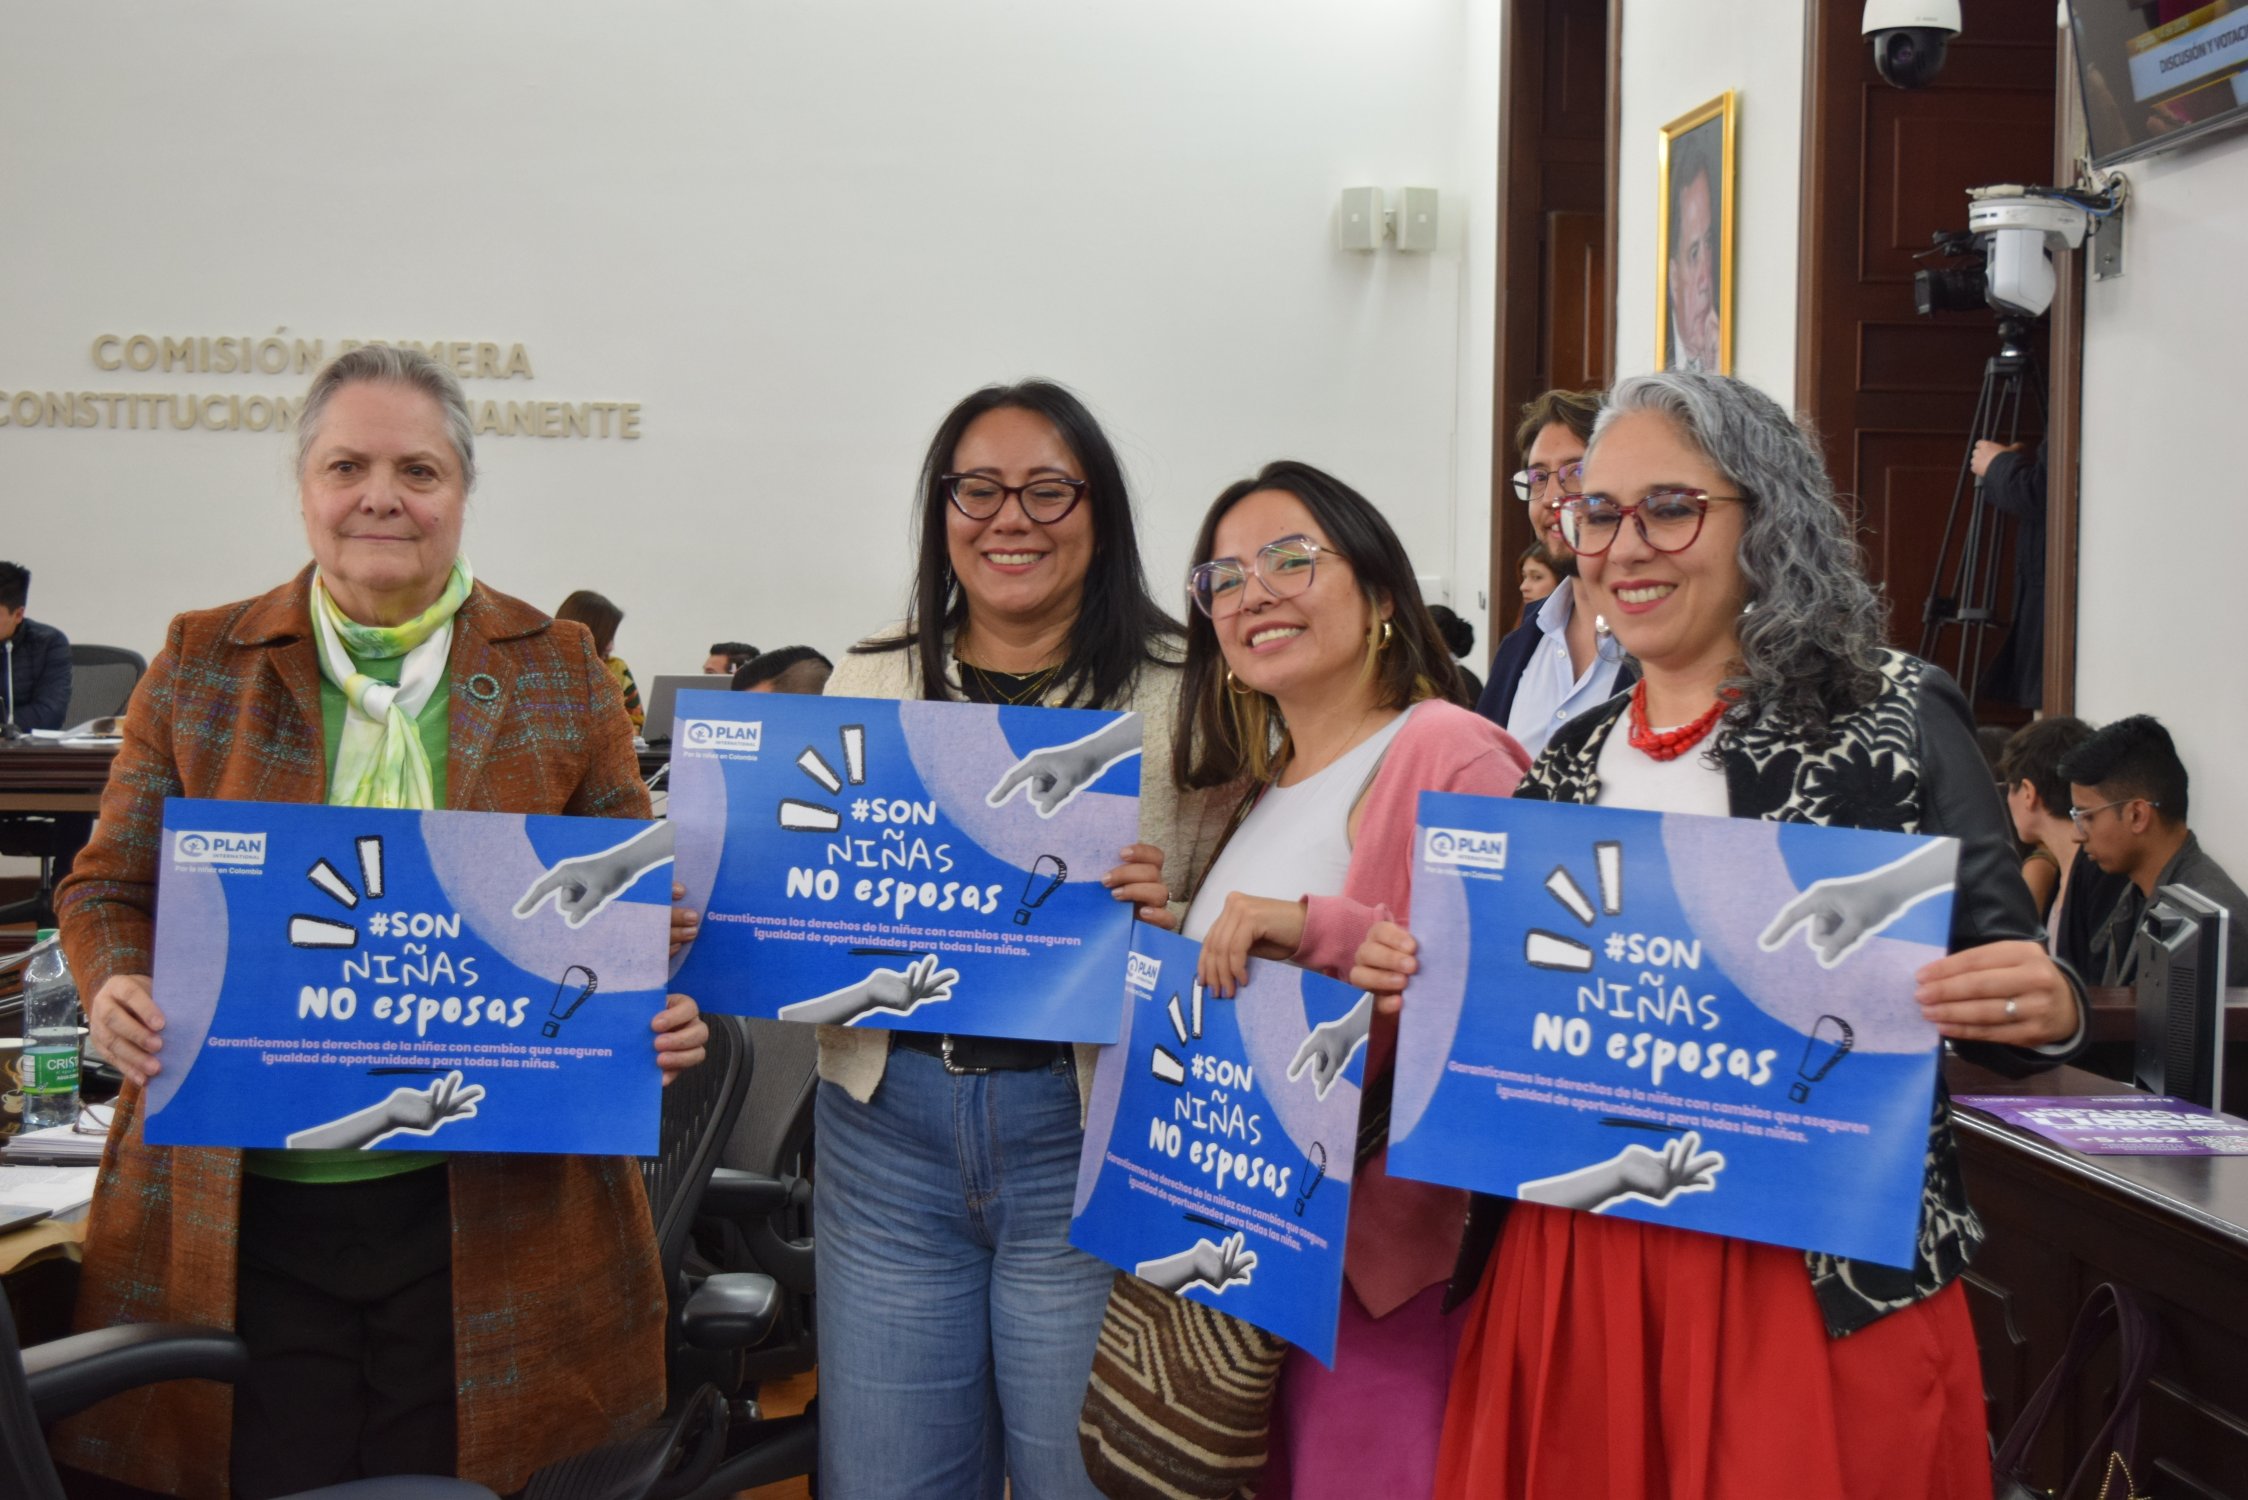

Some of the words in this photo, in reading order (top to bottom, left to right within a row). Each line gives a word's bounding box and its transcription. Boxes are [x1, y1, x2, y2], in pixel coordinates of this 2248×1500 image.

[2159, 42, 2207, 74] DISCUSIÓN
[2213, 25, 2248, 51] VOTAC
[92, 325, 322, 375] COMISIÓN
[716, 726, 757, 740] PLAN
[851, 797, 936, 826] #SON
[213, 838, 261, 852] PLAN
[827, 828, 954, 873] NIÑAS
[1458, 837, 1501, 854] PLAN
[229, 867, 263, 875] Colombia
[786, 866, 839, 901] NO
[854, 877, 1002, 921] esposas
[369, 911, 461, 939] #SON
[707, 911, 787, 927] Garanticemos
[789, 916, 805, 928] los
[807, 919, 860, 932] derechos
[862, 922, 877, 932] de
[878, 923, 890, 934] la
[892, 924, 923, 936] niñez
[924, 928, 946, 937] con
[948, 927, 999, 941] cambios
[1000, 932, 1024, 943] que
[1025, 934, 1081, 947] aseguren
[754, 927, 805, 941] igualdad
[807, 931, 821, 942] de
[822, 933, 908, 949] oportunidades
[909, 940, 937, 951] para
[939, 941, 973, 953] todas
[974, 943, 992, 954] las
[994, 943, 1031, 956] niñas.
[343, 942, 479, 987] NIÑAS
[1603, 931, 1701, 970] #SON
[298, 985, 357, 1020] NO
[373, 993, 530, 1037] esposas
[1577, 970, 1721, 1030] NIÑAS
[208, 1037, 299, 1049] Garanticemos
[301, 1039, 320, 1049] los
[322, 1039, 380, 1050] derechos
[382, 1040, 398, 1051] de
[400, 1040, 411, 1051] la
[414, 1041, 447, 1051] niñez
[449, 1044, 471, 1052] con
[473, 1043, 526, 1054] cambios
[529, 1046, 552, 1057] que
[554, 1047, 612, 1058] aseguren
[262, 1051, 319, 1065] igualdad
[322, 1053, 337, 1063] de
[339, 1053, 430, 1066] oportunidades
[433, 1057, 462, 1067] para
[464, 1056, 499, 1067] todas
[501, 1057, 519, 1068] las
[522, 1057, 559, 1069] niñas.
[1531, 1012, 1591, 1056] NO
[1606, 1032, 1777, 1086] esposas
[1190, 1053, 1252, 1092] #SON
[1175, 1090, 1262, 1146] NIÑAS
[1149, 1117, 1181, 1158] NO
[1189, 1140, 1292, 1198] esposas
